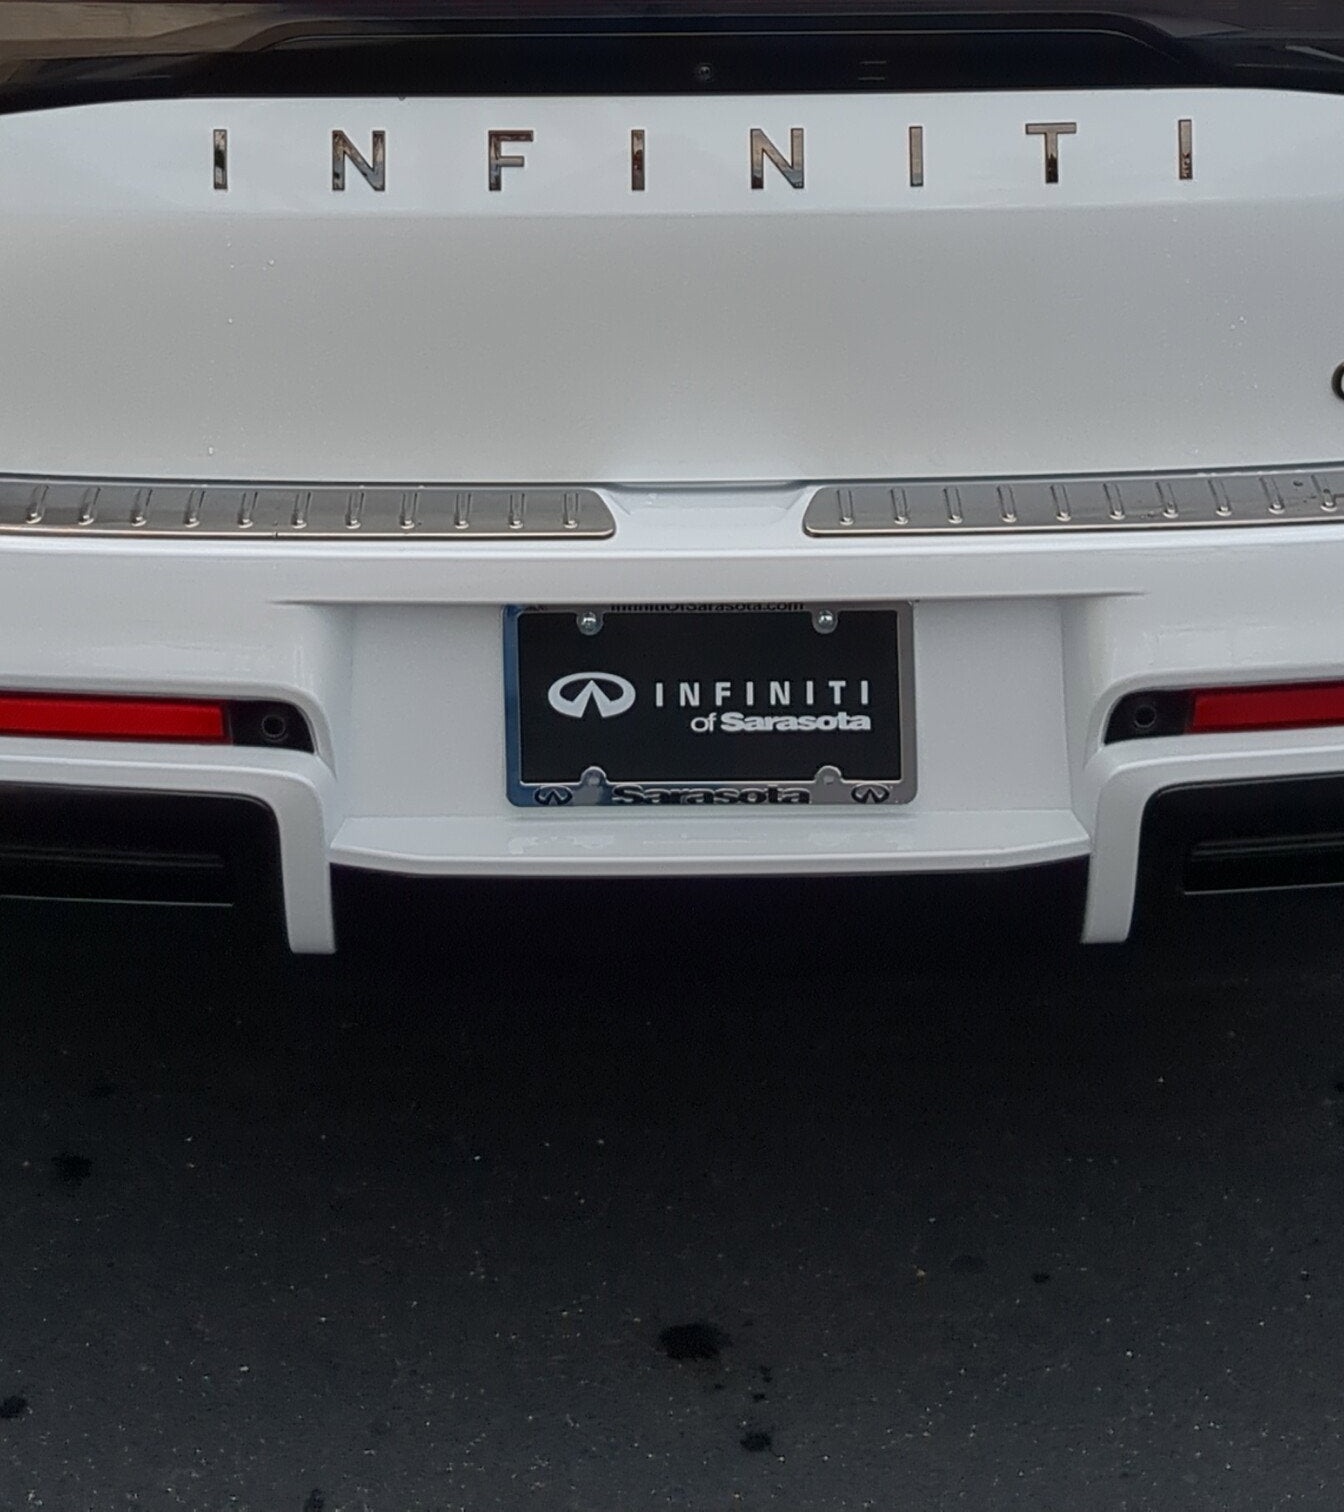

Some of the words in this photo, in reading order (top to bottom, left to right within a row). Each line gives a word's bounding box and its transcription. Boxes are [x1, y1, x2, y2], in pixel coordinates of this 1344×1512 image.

[213, 119, 1193, 191] INFINITI
[655, 680, 869, 707] INFINITI
[690, 712, 717, 732] of
[720, 712, 871, 732] Sarasota
[612, 784, 812, 805] Sarasota
